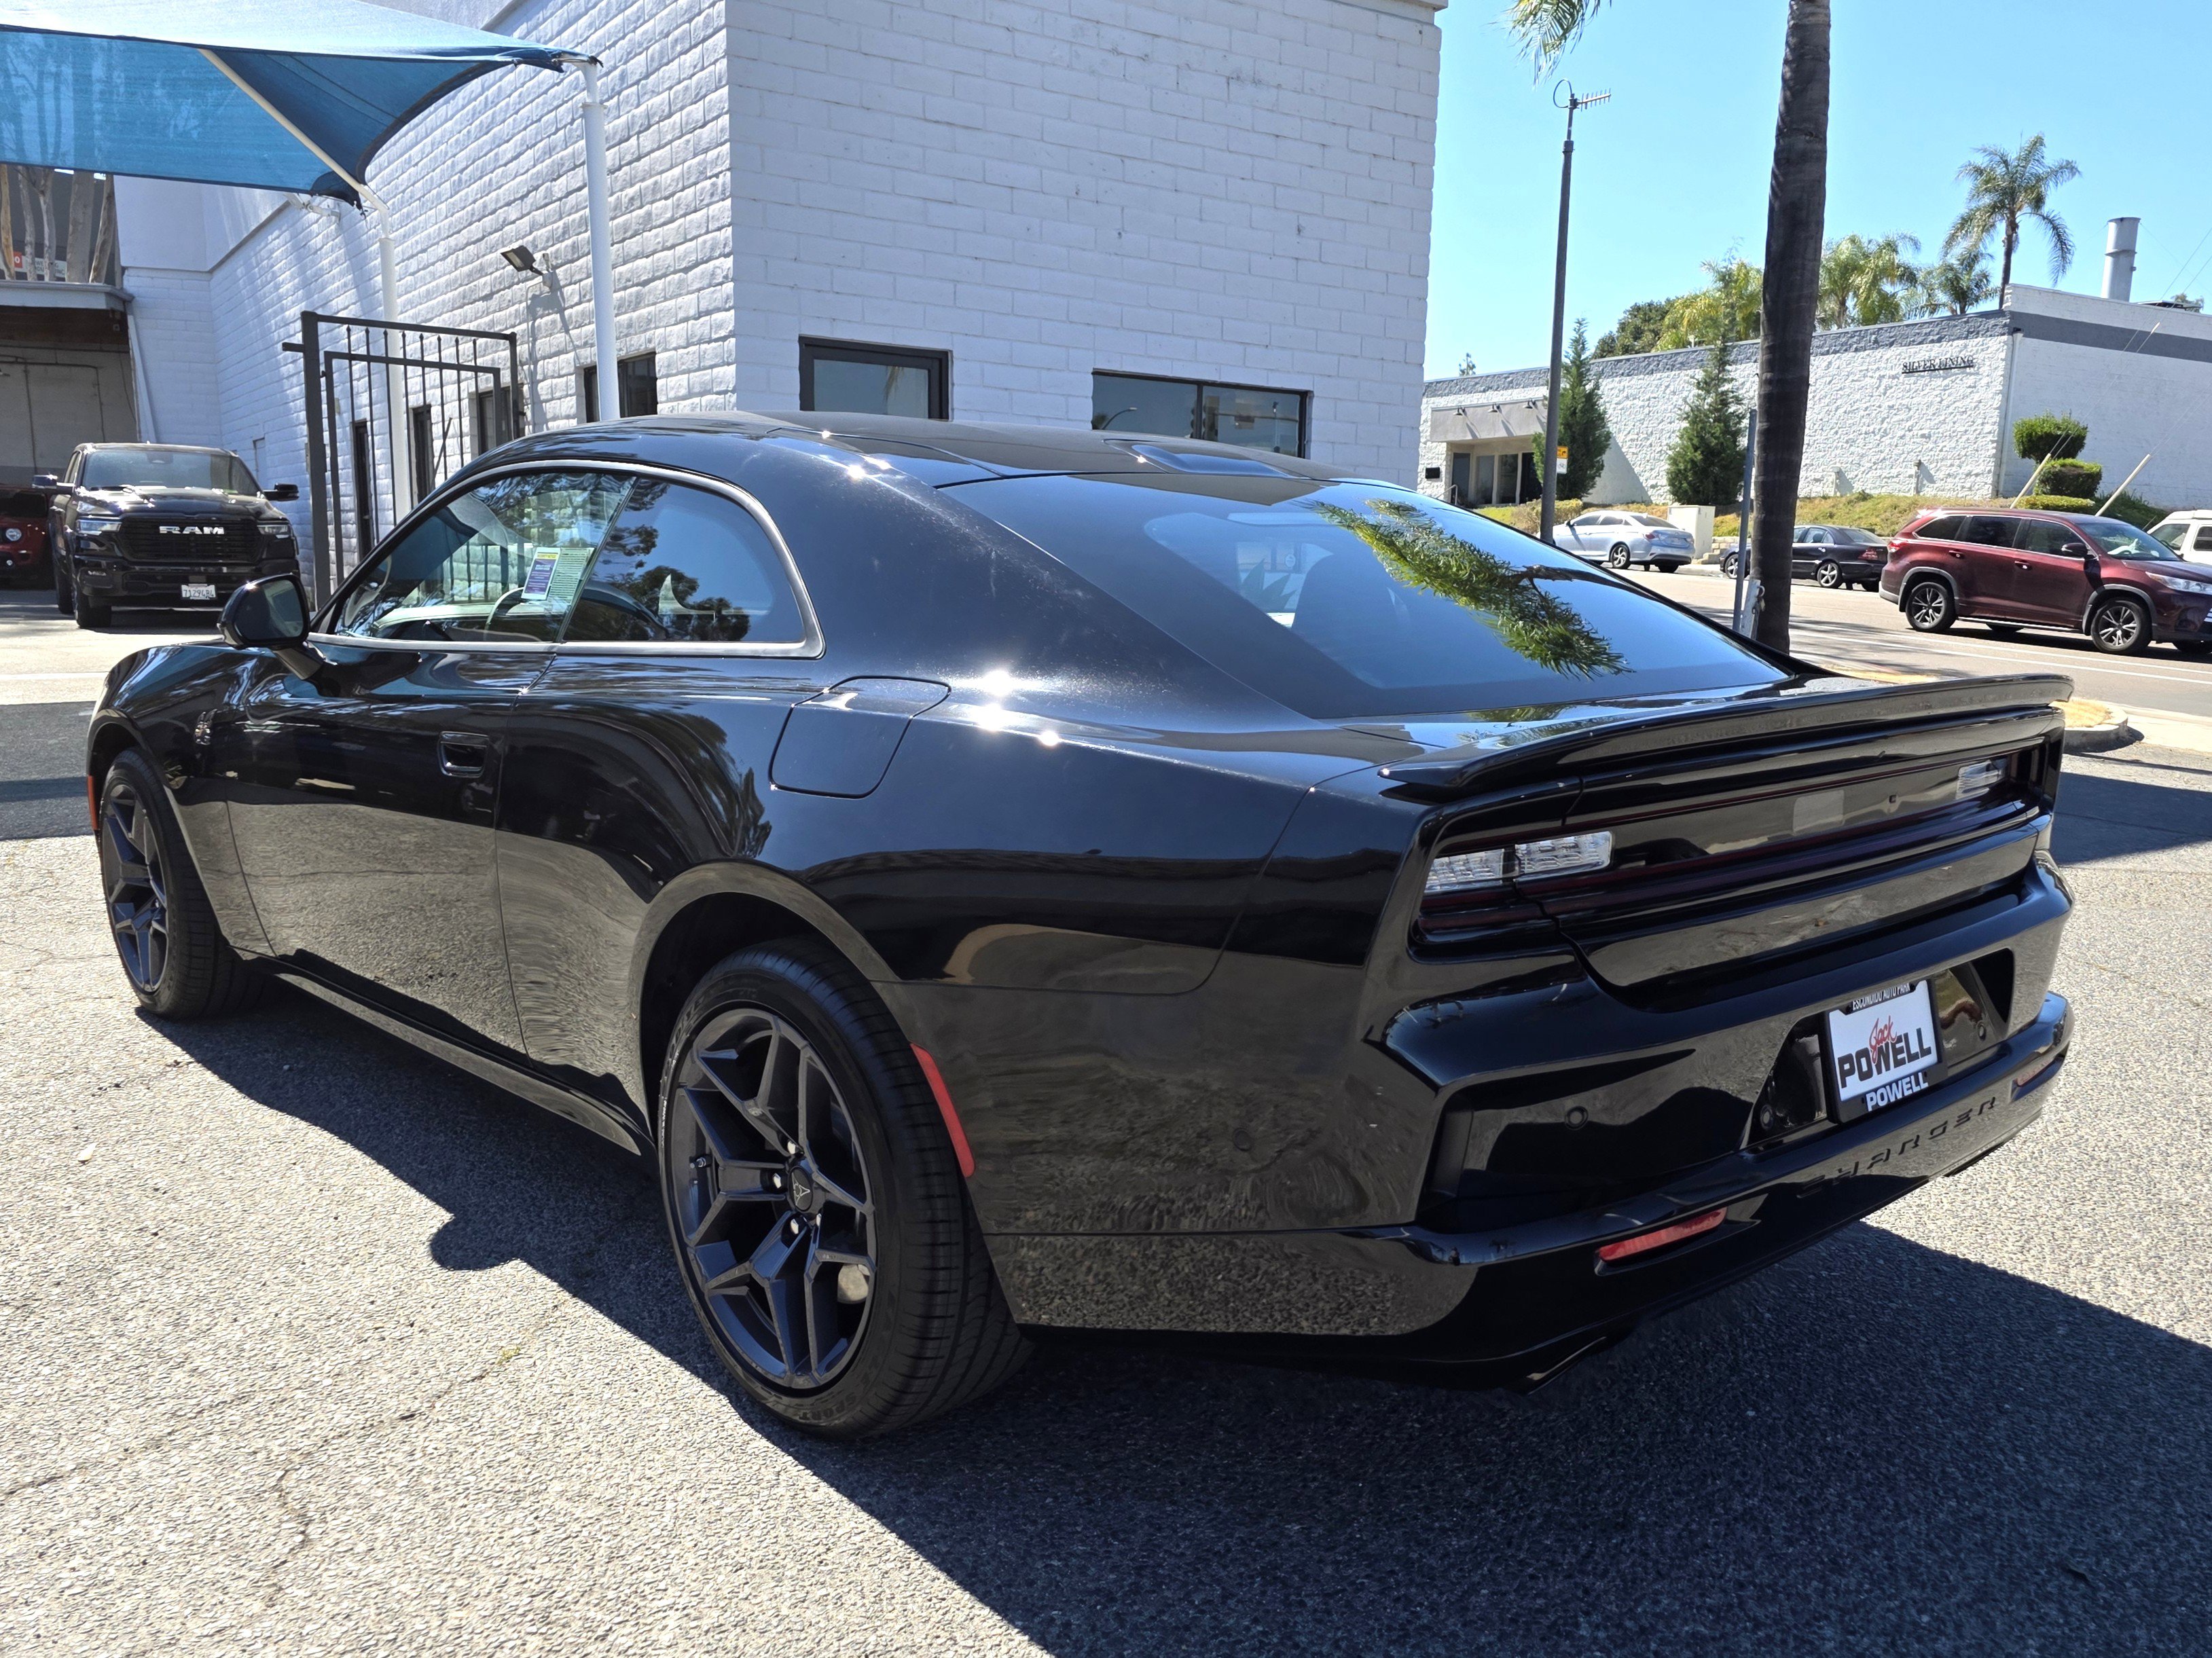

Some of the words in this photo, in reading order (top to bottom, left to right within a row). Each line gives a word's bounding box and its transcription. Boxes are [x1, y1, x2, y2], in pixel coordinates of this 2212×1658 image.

[1902, 359, 1936, 371] SILVER
[1938, 355, 1973, 368] LINING
[159, 526, 225, 535] RAM
[1853, 993, 1883, 1011] ESCONDIDO
[1883, 986, 1897, 1001] AUTO
[1898, 982, 1911, 995] PARK
[1869, 1015, 1898, 1064] Jack
[1837, 1027, 1932, 1089] POWELL
[1866, 1072, 1929, 1112] POWELL
